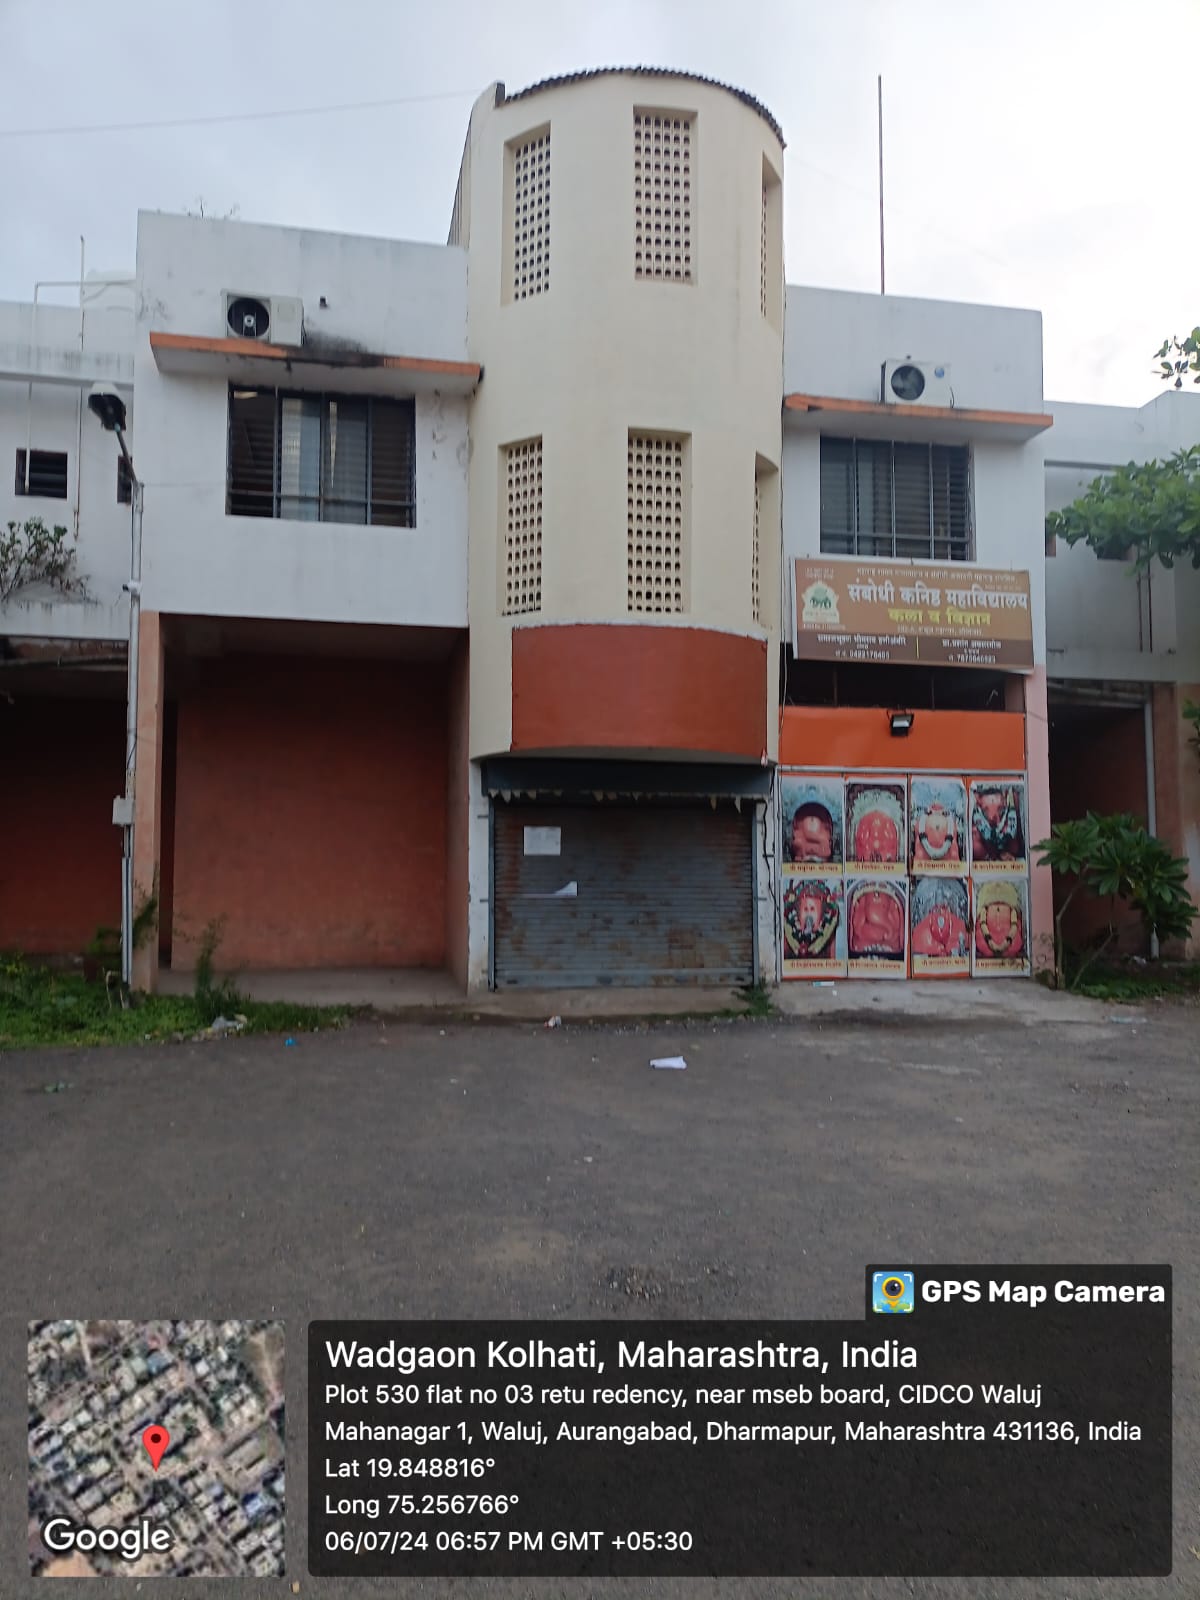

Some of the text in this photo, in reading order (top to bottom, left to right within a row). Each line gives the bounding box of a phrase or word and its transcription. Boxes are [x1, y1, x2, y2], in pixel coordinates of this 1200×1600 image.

[848, 579, 895, 603] संबोधी
[945, 584, 1028, 610] महाविद्यालय
[888, 606, 991, 627] कला व विज्ञान
